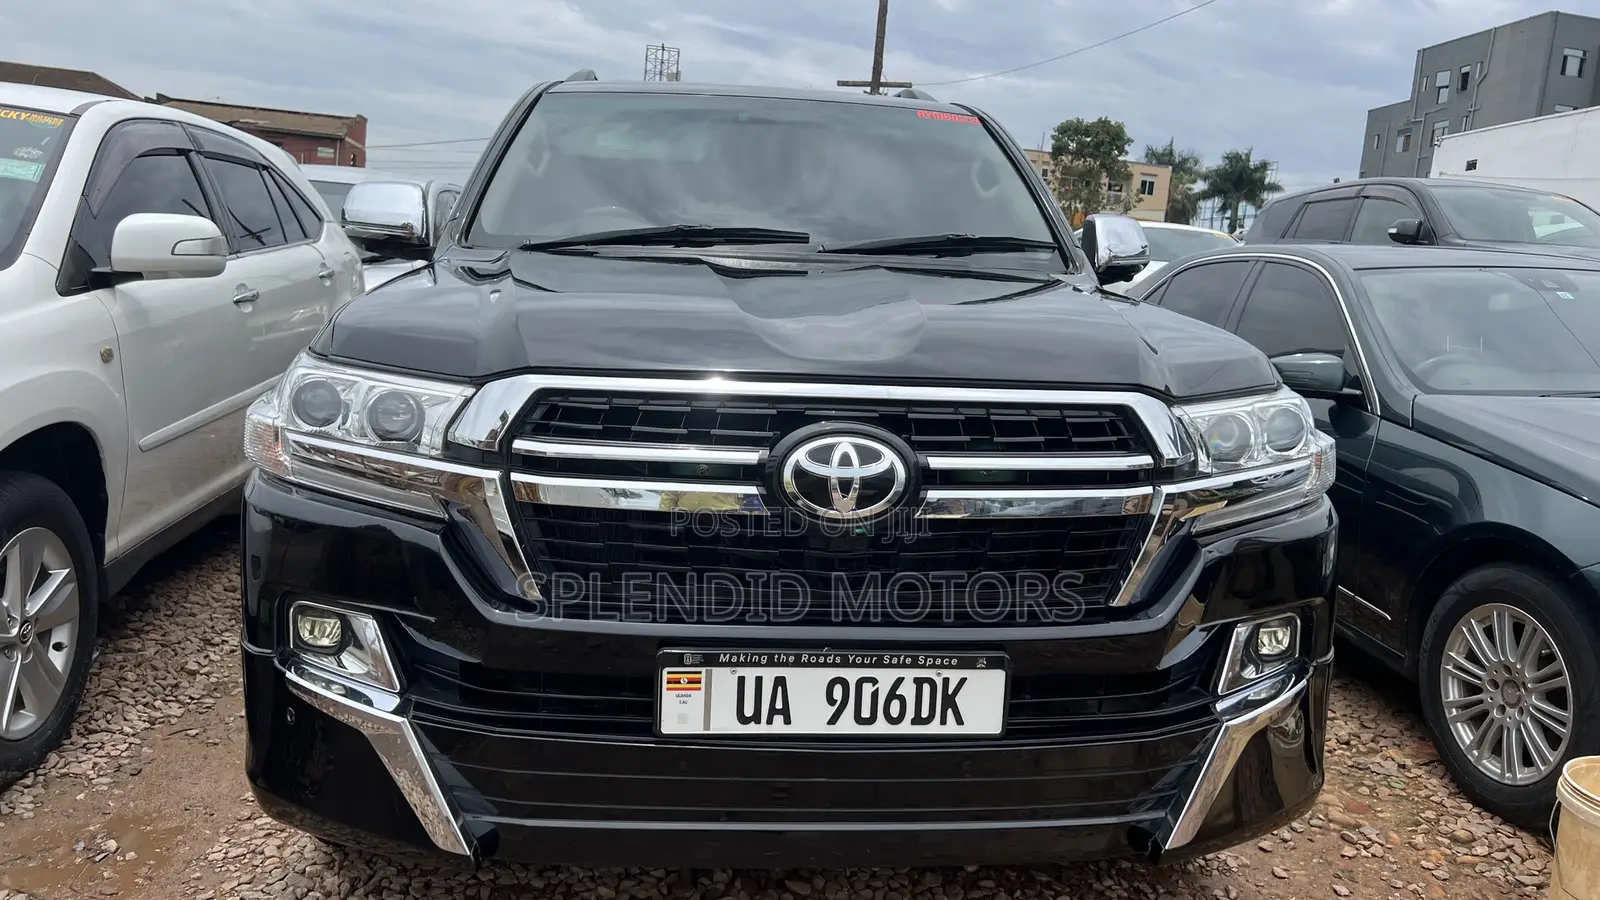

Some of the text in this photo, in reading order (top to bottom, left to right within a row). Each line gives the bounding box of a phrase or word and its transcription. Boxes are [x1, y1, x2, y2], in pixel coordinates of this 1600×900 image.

[0, 109, 30, 120] CKY
[719, 653, 958, 666] Making the Roads Your Safe Space
[736, 675, 968, 726] UA 906DK
